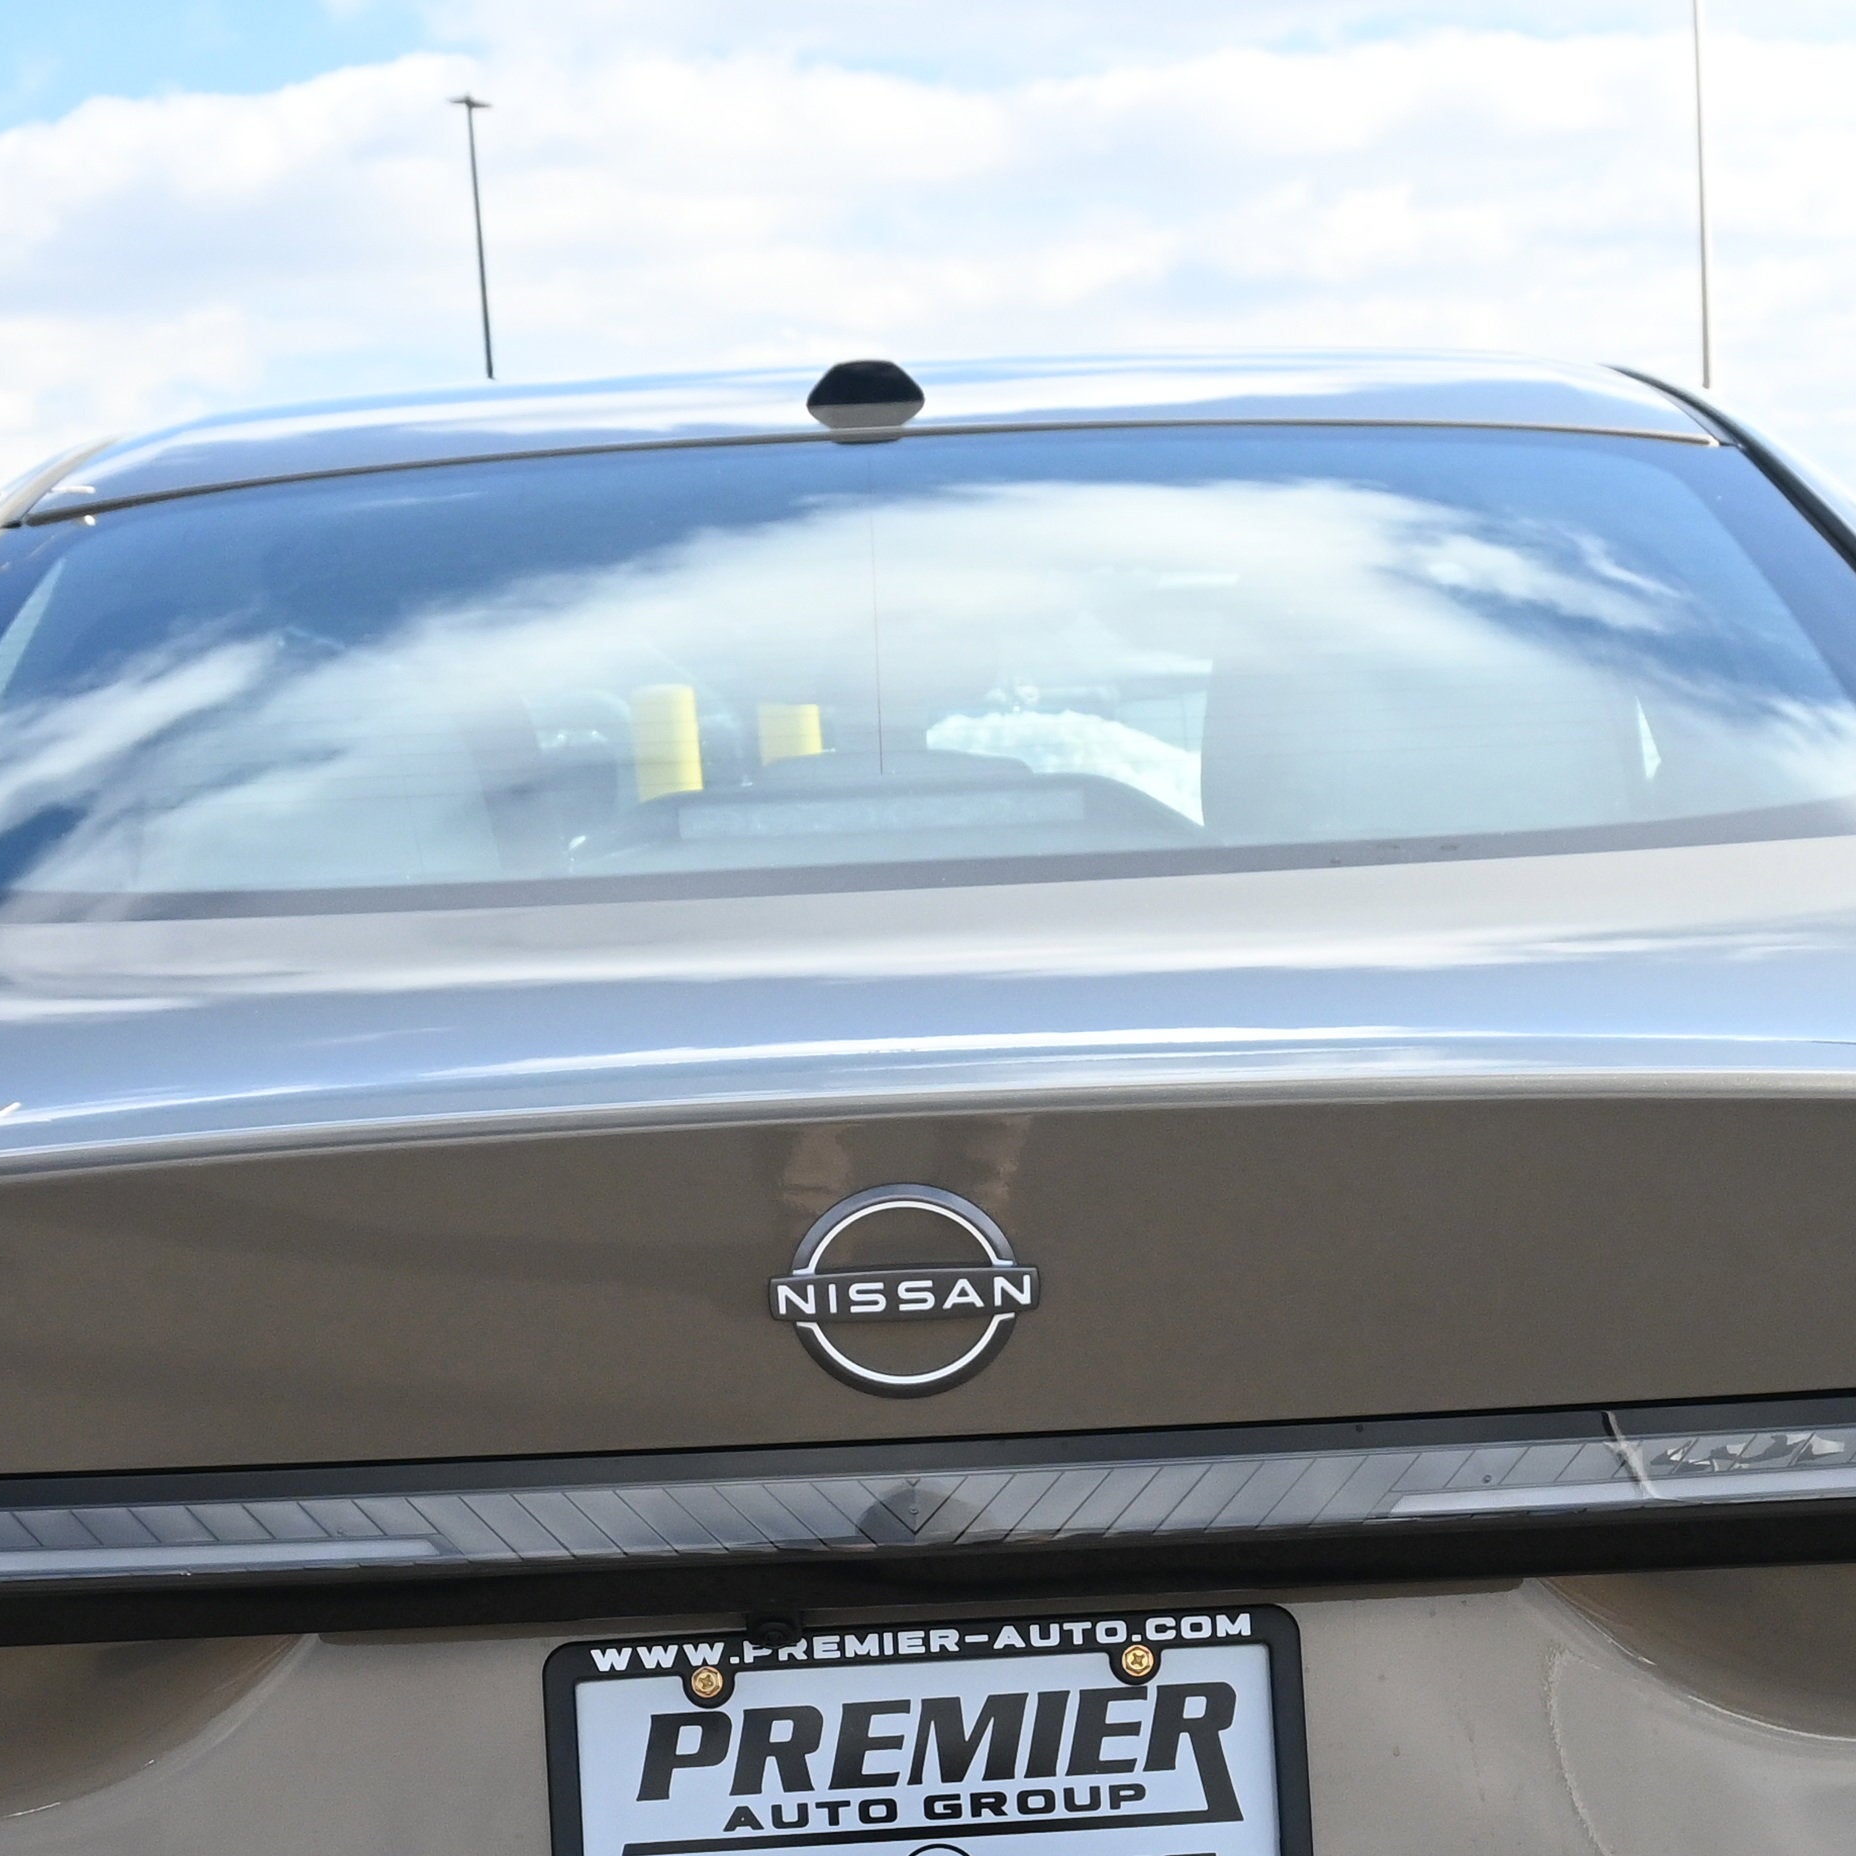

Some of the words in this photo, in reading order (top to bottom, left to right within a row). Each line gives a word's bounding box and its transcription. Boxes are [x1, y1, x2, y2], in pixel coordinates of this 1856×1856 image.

[777, 1274, 1031, 1315] NISSAN
[590, 1613, 1252, 1672] WWW.PREMIER-AUTO.COM
[637, 1682, 1244, 1821] PREMIER
[723, 1799, 898, 1832] AUTO
[923, 1783, 1146, 1821] GROUP
